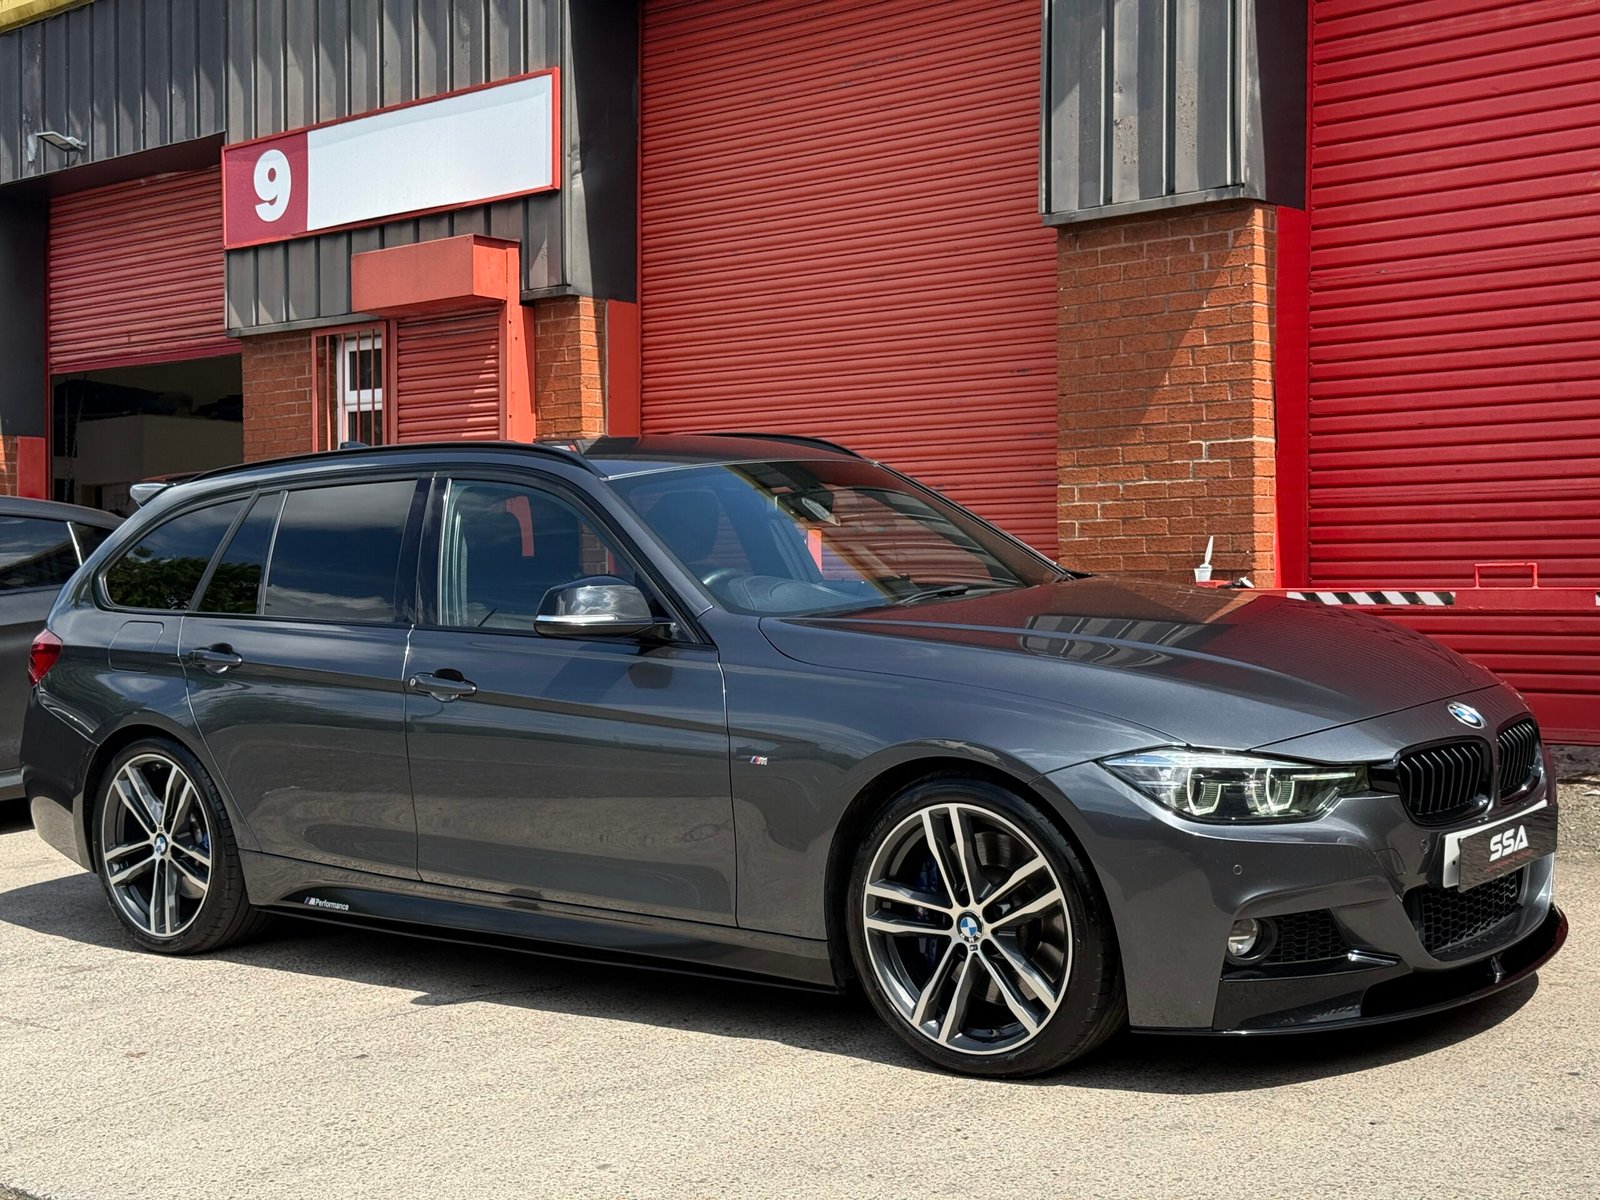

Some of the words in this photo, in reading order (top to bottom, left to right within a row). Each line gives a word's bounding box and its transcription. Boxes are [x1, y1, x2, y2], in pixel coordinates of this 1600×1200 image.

[253, 149, 292, 223] 9
[1489, 824, 1529, 863] SSA
[315, 898, 350, 911] Performance
